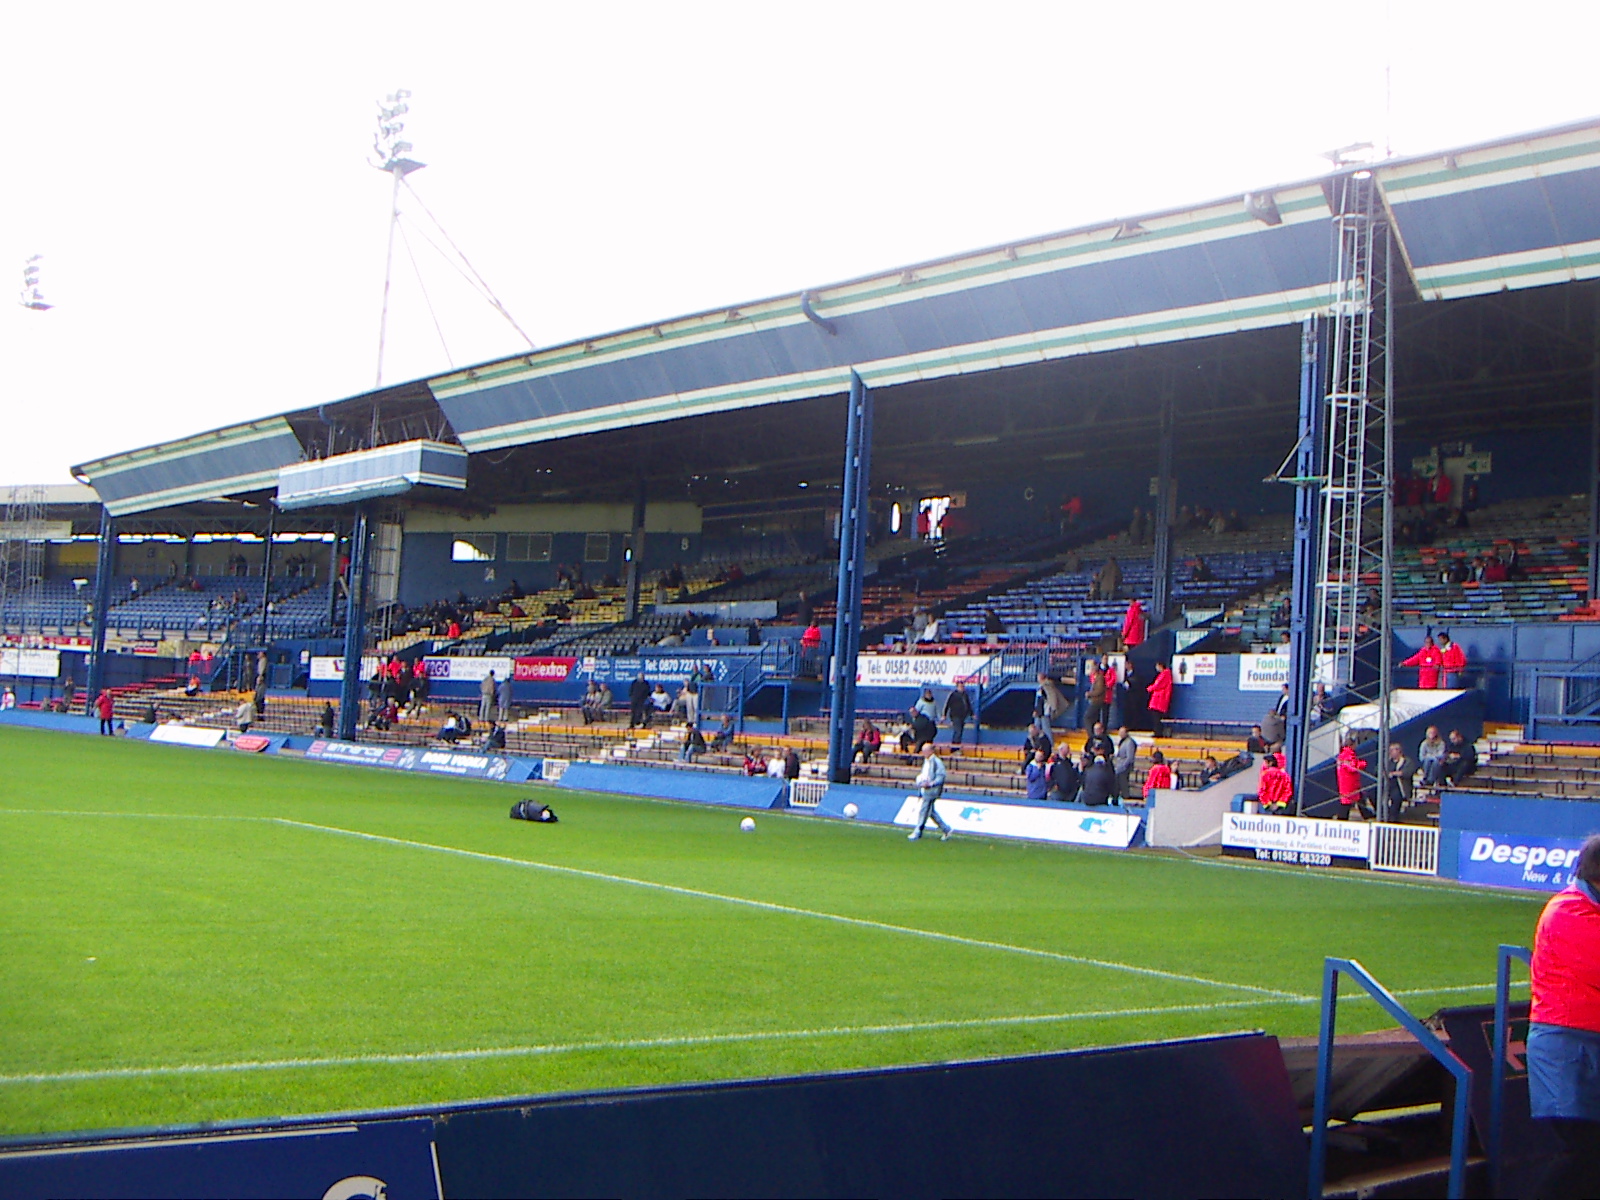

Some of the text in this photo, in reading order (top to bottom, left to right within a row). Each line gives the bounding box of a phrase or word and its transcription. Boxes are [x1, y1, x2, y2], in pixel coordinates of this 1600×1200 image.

[515, 660, 568, 677] travelextras
[645, 658, 658, 672] Tel:
[659, 658, 679, 672] 0870
[867, 659, 948, 675] Tel: 01582 458000
[1229, 815, 1361, 845] Sundon Dry Lining
[1255, 848, 1271, 860] Tel:
[1470, 837, 1580, 871] Desper
[1522, 870, 1549, 883] New
[1551, 872, 1562, 885] &
